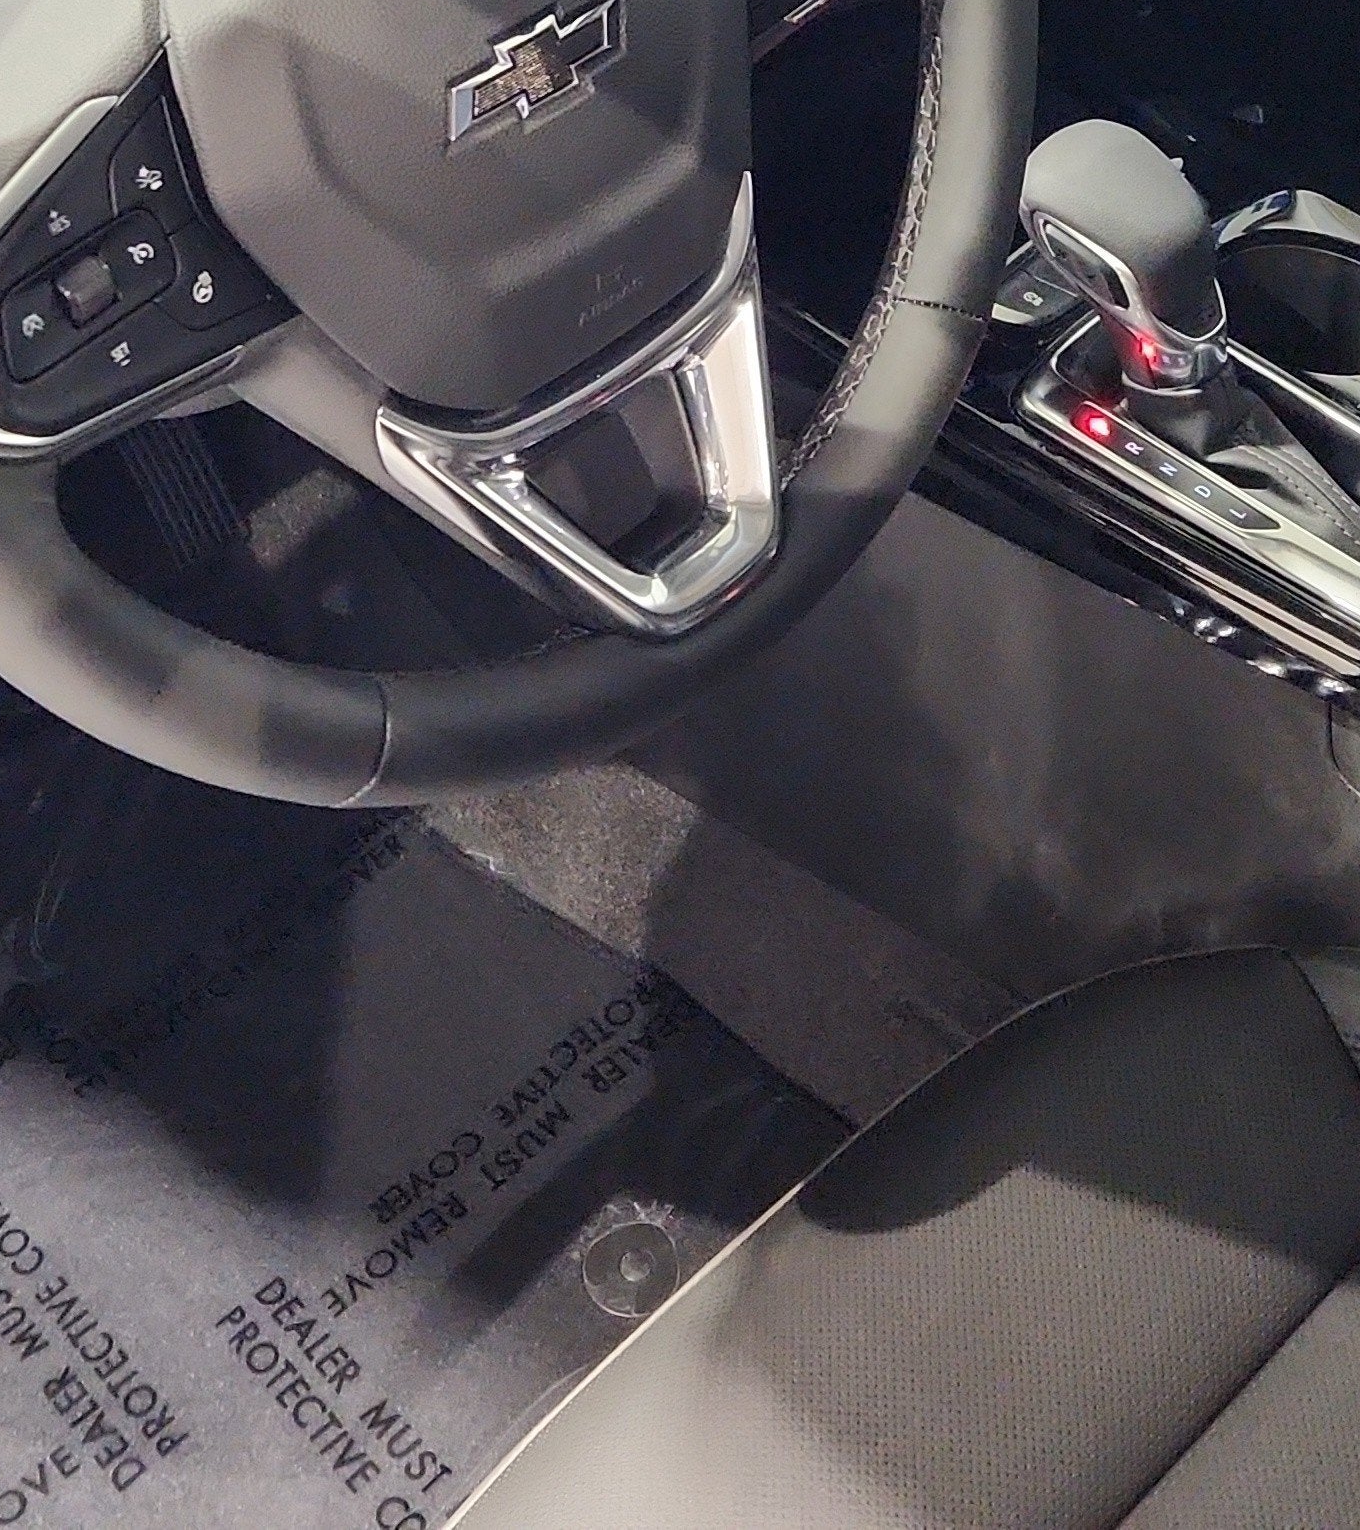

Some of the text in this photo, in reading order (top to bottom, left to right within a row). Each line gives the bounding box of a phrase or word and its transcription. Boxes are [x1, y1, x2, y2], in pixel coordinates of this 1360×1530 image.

[1124, 441, 1144, 456] R
[1158, 462, 1178, 477] N
[1194, 485, 1212, 498] D
[1228, 508, 1247, 519] L
[367, 967, 662, 1224] ROTECTIVE COVER
[480, 1100, 571, 1191] MUST
[320, 1191, 469, 1318] REMOVE
[35, 1276, 190, 1457] PROTECTIVE
[43, 1366, 148, 1492] DEALER
[215, 1305, 381, 1494] PROTECTIVE
[255, 1276, 453, 1493] DEALER MUST
